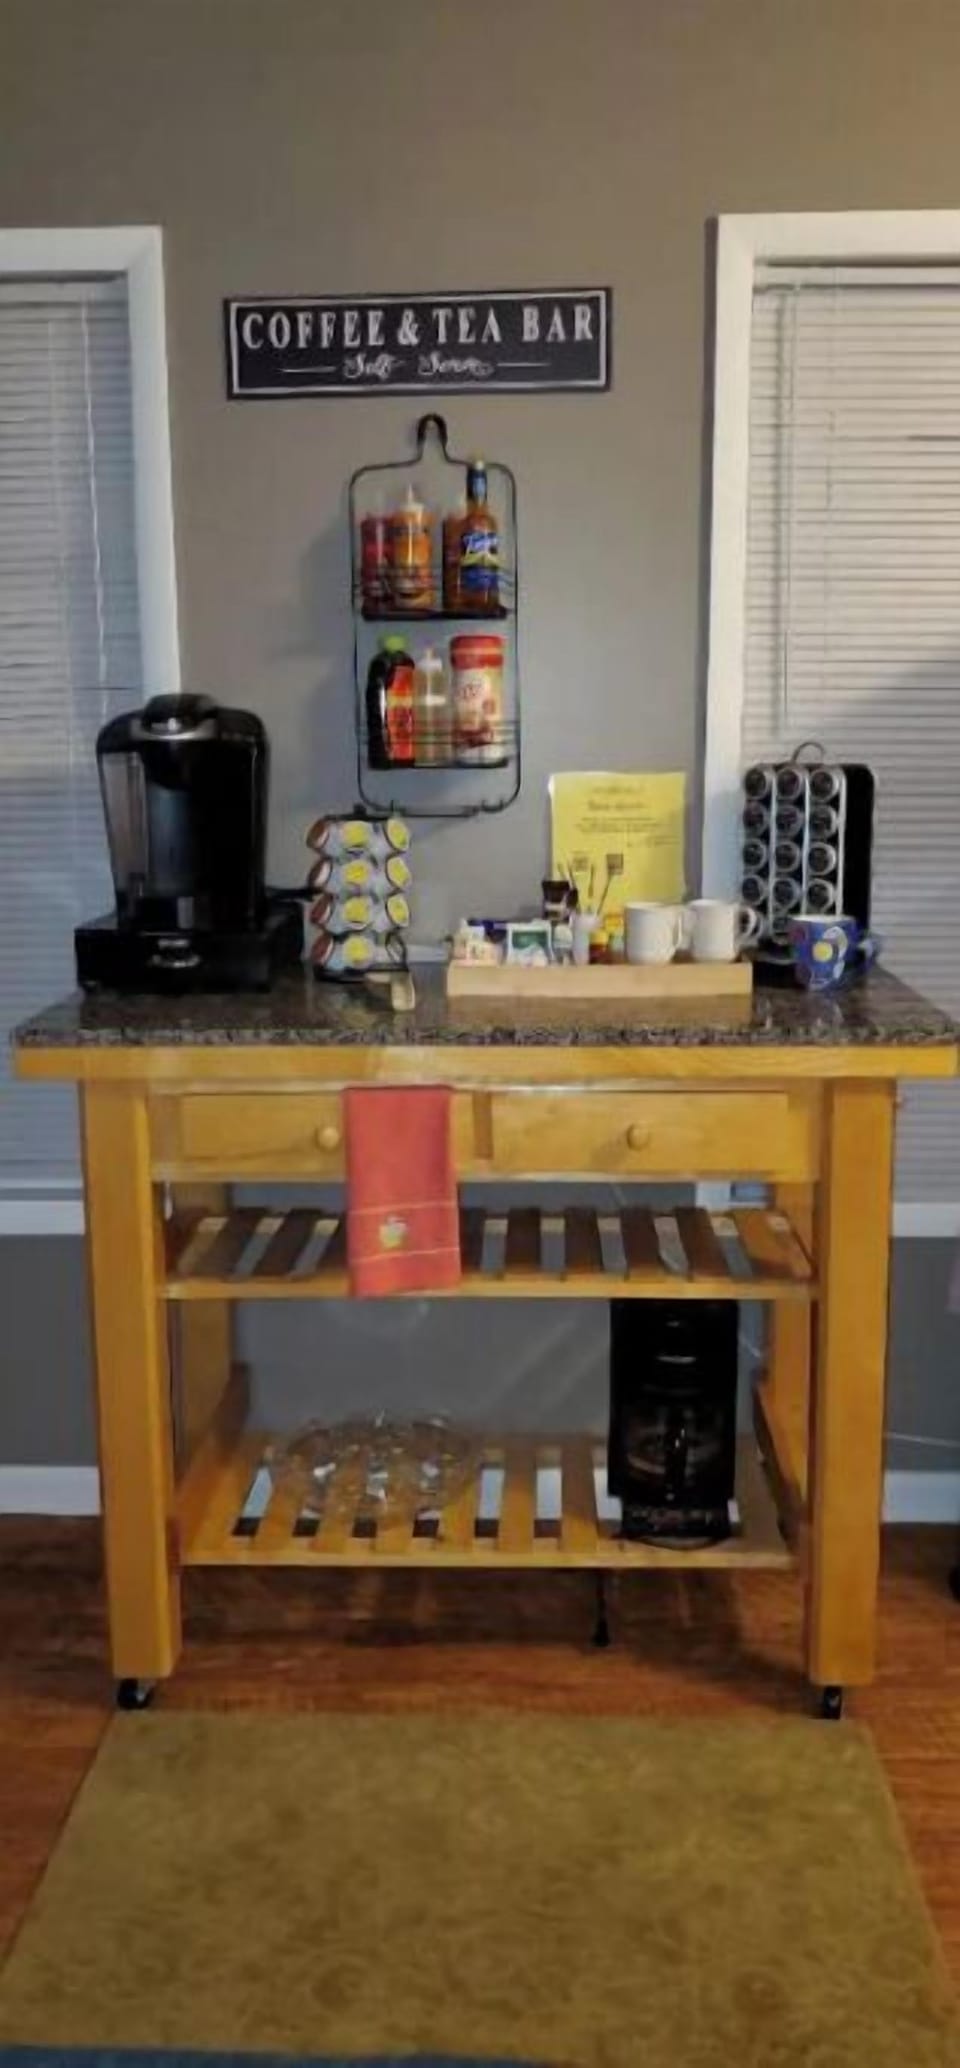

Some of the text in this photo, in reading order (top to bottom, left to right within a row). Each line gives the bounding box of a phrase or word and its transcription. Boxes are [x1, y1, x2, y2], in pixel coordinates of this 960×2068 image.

[242, 303, 594, 350] COFFEE & TEA BAR
